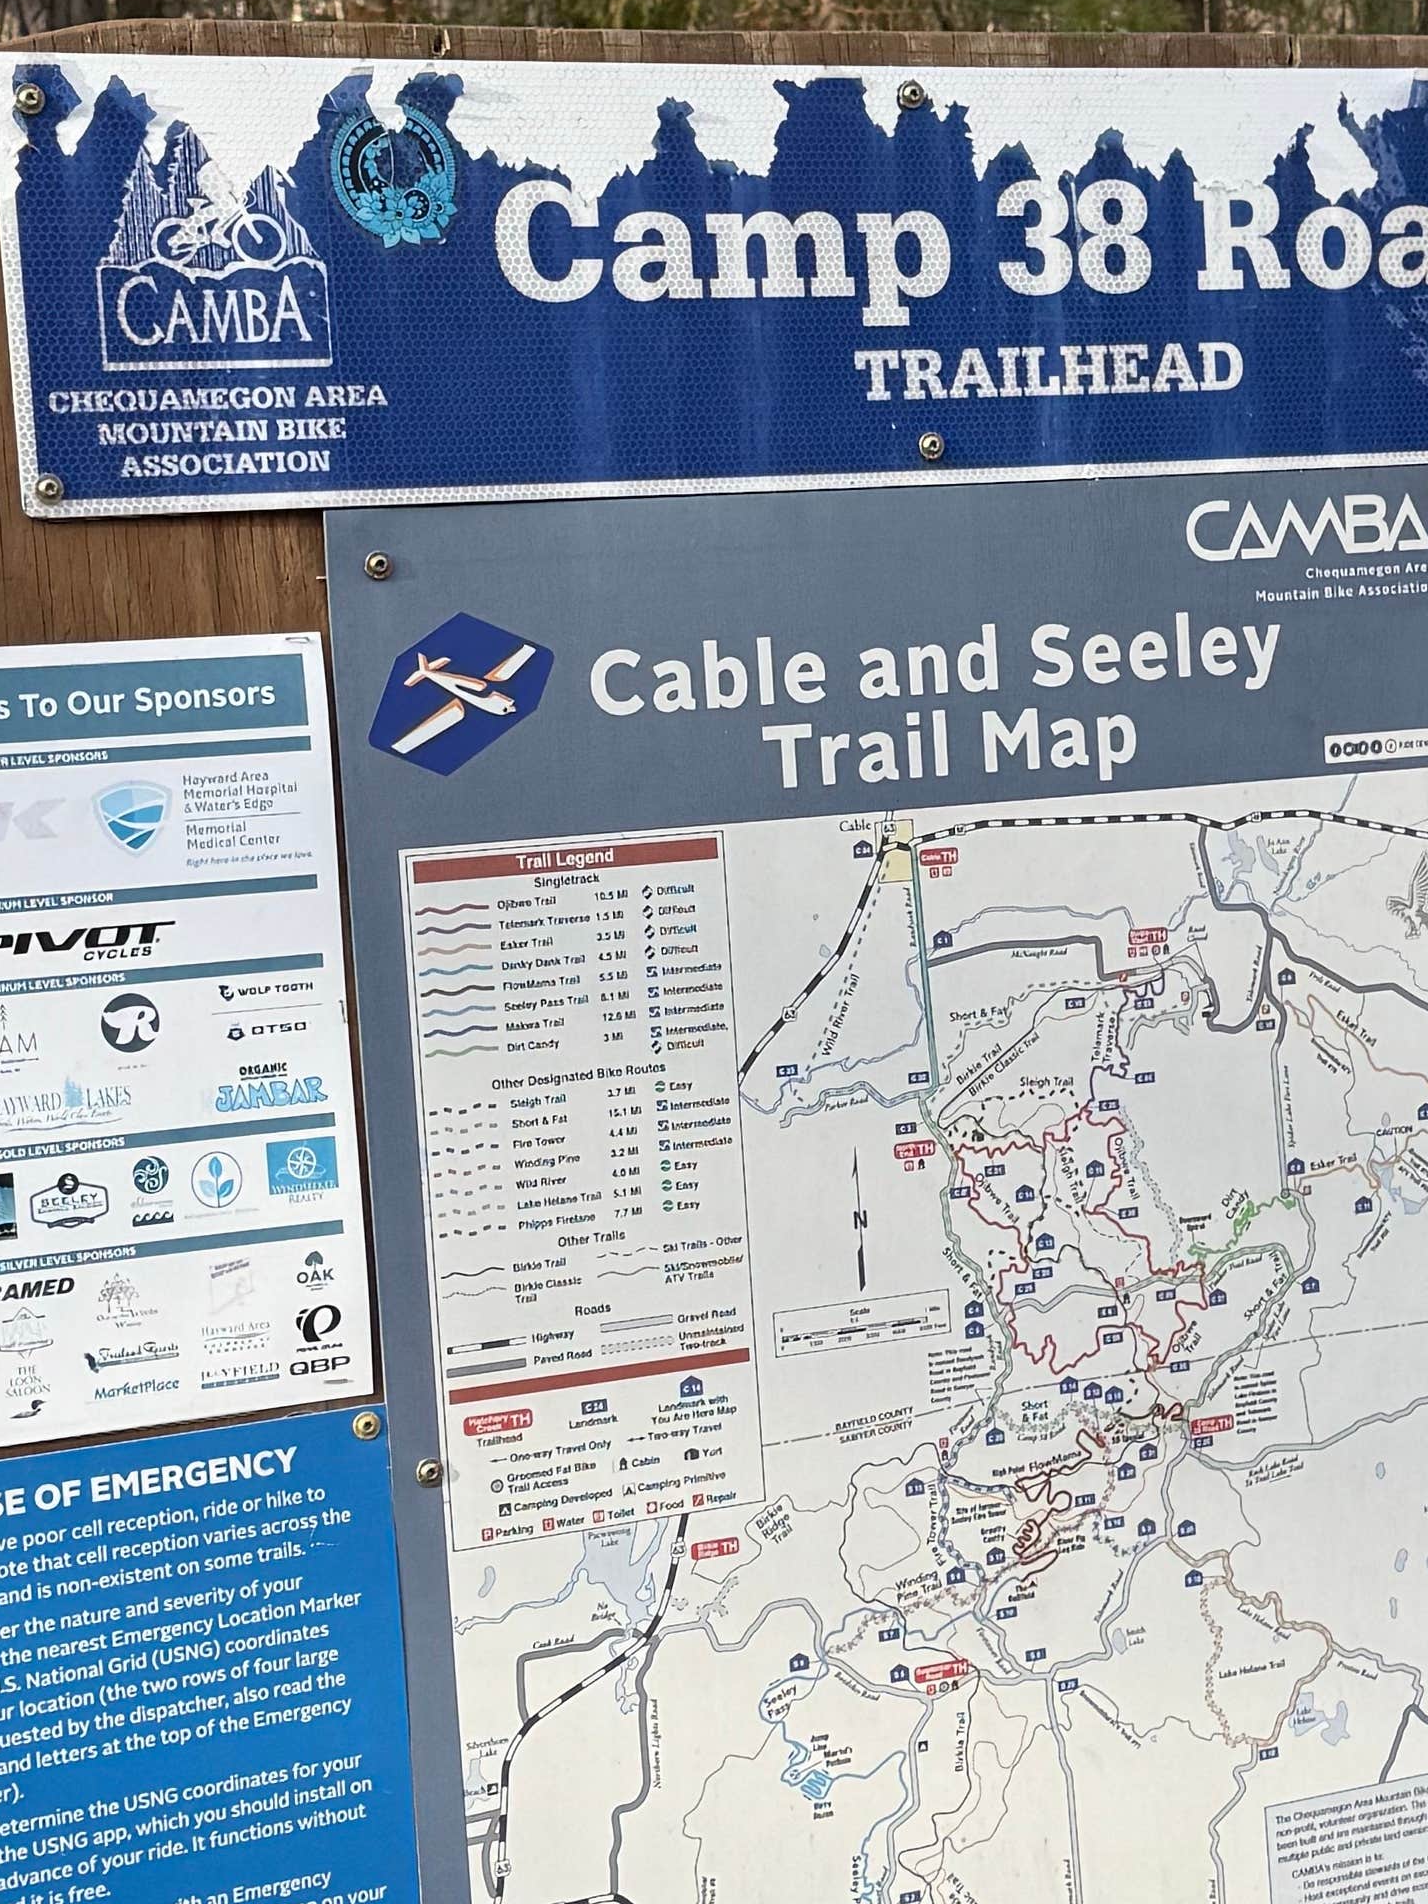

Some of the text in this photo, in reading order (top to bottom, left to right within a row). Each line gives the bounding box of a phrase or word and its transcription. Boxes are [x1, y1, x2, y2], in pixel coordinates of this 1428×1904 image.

[494, 179, 951, 327] Camp
[995, 179, 1152, 297] 38
[117, 275, 312, 346] CAMBA
[854, 341, 1244, 400] TRAILHEAD
[49, 384, 389, 414] CHEQUAMEGON AREA
[98, 417, 346, 446] MOUNTAIN BIKE
[121, 450, 330, 477] ASSOCIATION
[1305, 565, 1400, 579] Chequamegon
[1256, 587, 1319, 601] Mountain
[1324, 585, 1353, 598] Bike
[590, 611, 1280, 715] Cable and Seeley
[18, 693, 57, 717] To
[67, 690, 124, 715] Our
[134, 685, 275, 716] Sponsors
[761, 707, 1136, 788] Trail Map
[183, 781, 297, 799] Memorial Hospital
[186, 820, 246, 835] Memorial
[839, 820, 871, 832] Cable
[187, 834, 280, 849] Medical Center
[515, 847, 613, 869] Trail Legend
[84, 946, 151, 961] CYCLES
[28, 978, 64, 990] LEVEL
[65, 972, 125, 987] SPONSORS
[216, 1077, 328, 1113] JAMBAR
[28, 1144, 63, 1156] LEVEL
[65, 1136, 125, 1152] SPONSORS
[296, 1269, 335, 1283] OAK
[289, 1356, 350, 1376] QBP
[94, 1378, 179, 1400] MarketPlace
[34, 1479, 81, 1510] OF
[90, 1446, 296, 1502] EMERGENCY
[22, 1528, 67, 1551] poor
[71, 1519, 102, 1539] cell
[107, 1508, 198, 1534] reception,
[203, 1499, 237, 1518] ride
[242, 1497, 262, 1512] or
[266, 1490, 302, 1508] hike
[306, 1488, 325, 1502] to
